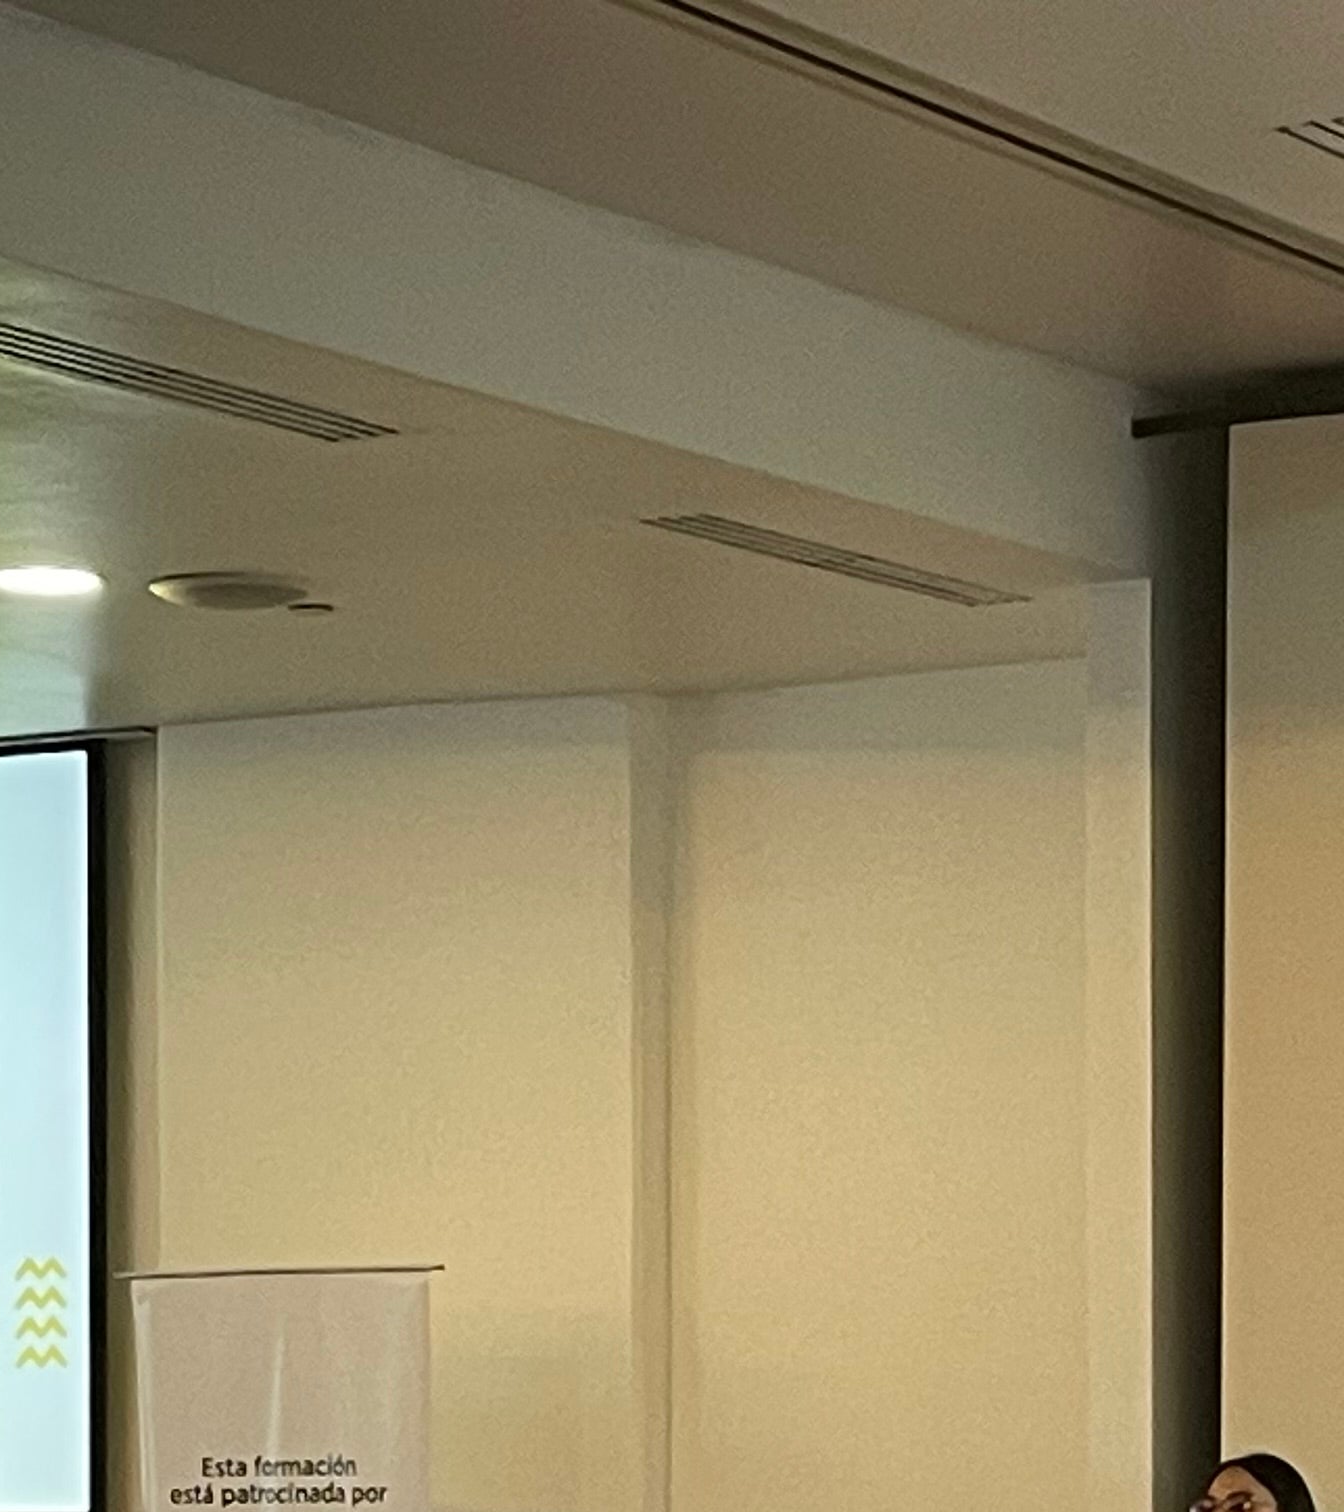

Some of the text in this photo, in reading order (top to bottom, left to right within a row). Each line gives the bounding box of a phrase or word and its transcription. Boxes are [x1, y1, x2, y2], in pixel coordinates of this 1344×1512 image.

[201, 1454, 357, 1478] Esta formación
[169, 1482, 388, 1507] está patrocinada por
